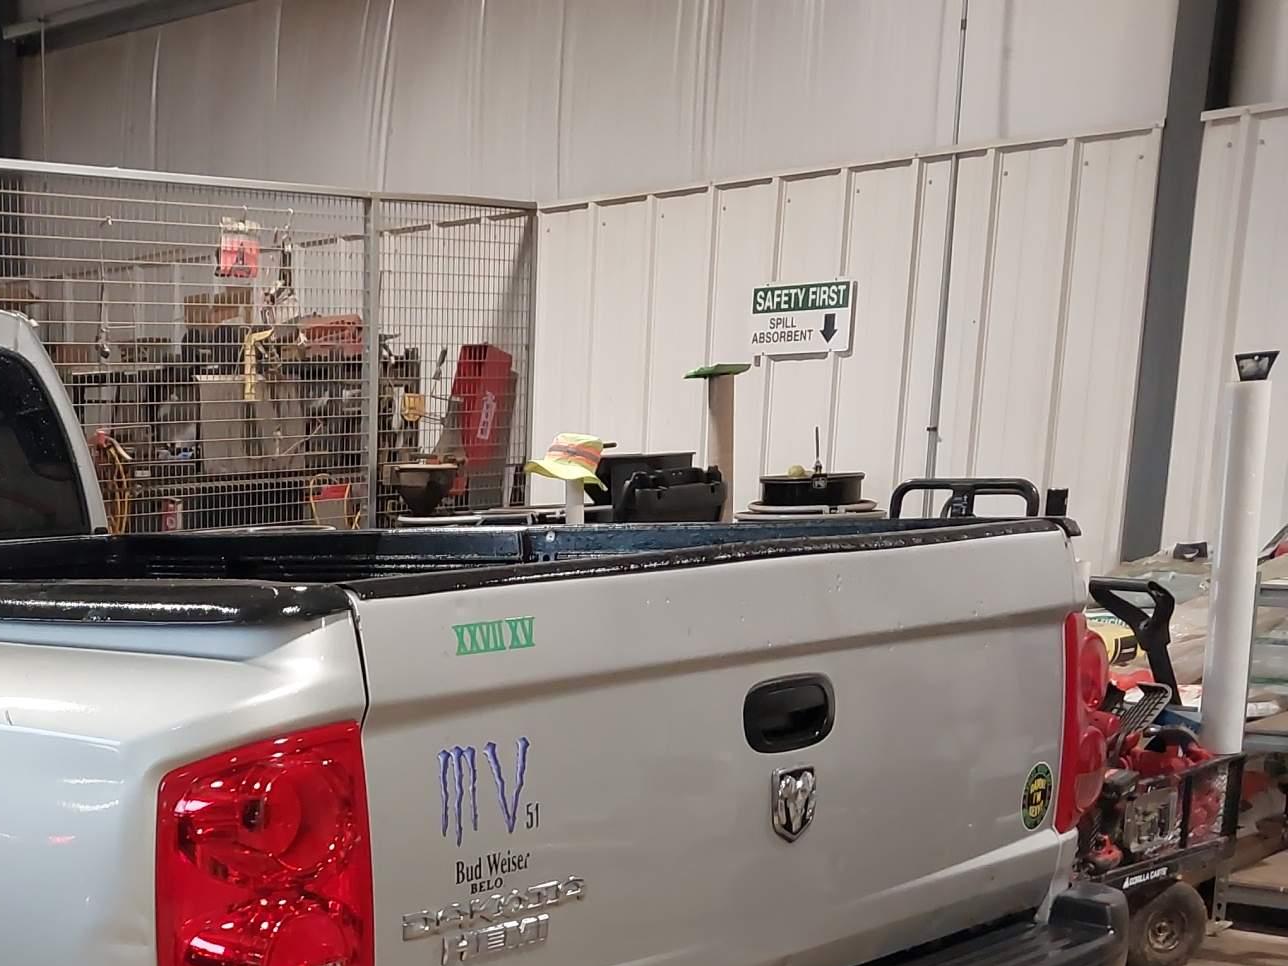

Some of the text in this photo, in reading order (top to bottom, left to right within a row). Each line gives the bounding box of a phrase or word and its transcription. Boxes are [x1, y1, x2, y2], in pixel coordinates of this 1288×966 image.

[756, 285, 846, 311] SAFETY FIRST
[752, 316, 813, 344] SPILL ABSORBENT
[504, 616, 536, 649] XV
[525, 802, 540, 829] 51
[455, 850, 530, 885] Bud Weiser
[470, 877, 504, 895] BELO
[402, 875, 585, 942] DAKOTA
[441, 914, 549, 966] HEMI
